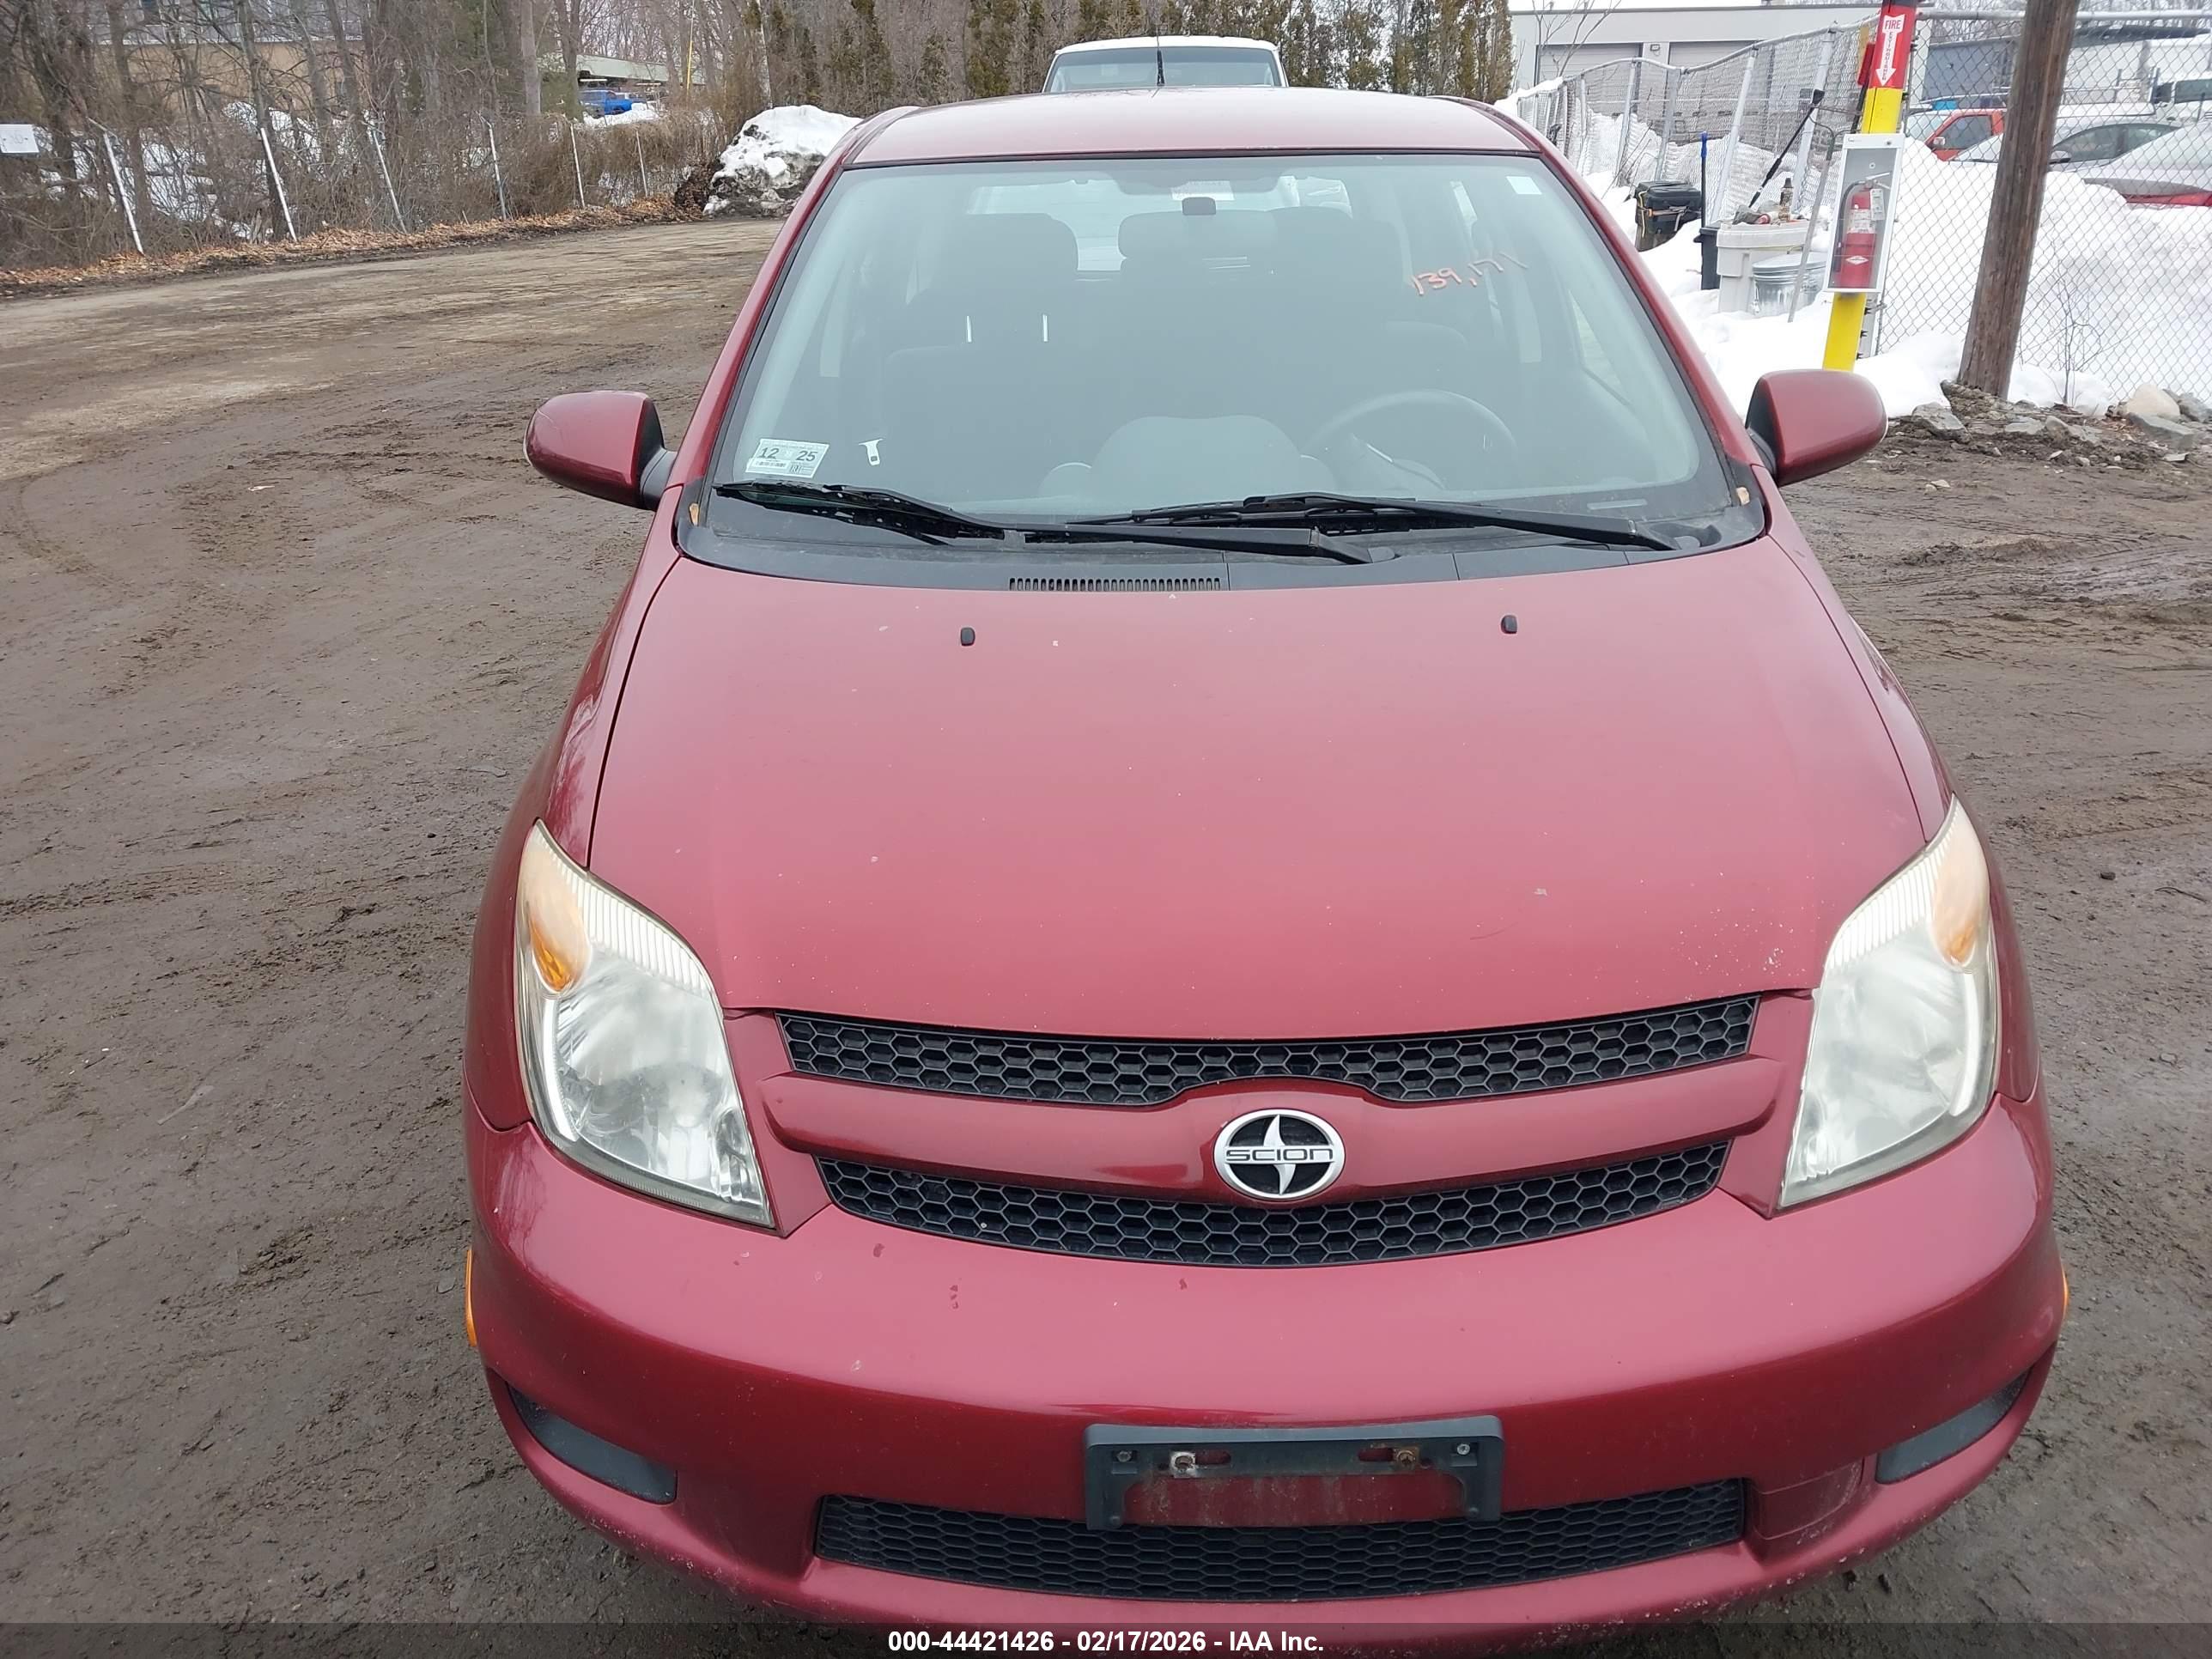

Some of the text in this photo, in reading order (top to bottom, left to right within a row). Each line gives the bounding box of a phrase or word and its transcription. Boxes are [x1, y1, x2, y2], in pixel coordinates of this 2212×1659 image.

[1885, 20, 1901, 29] FIRE
[758, 447, 817, 461] 12 25
